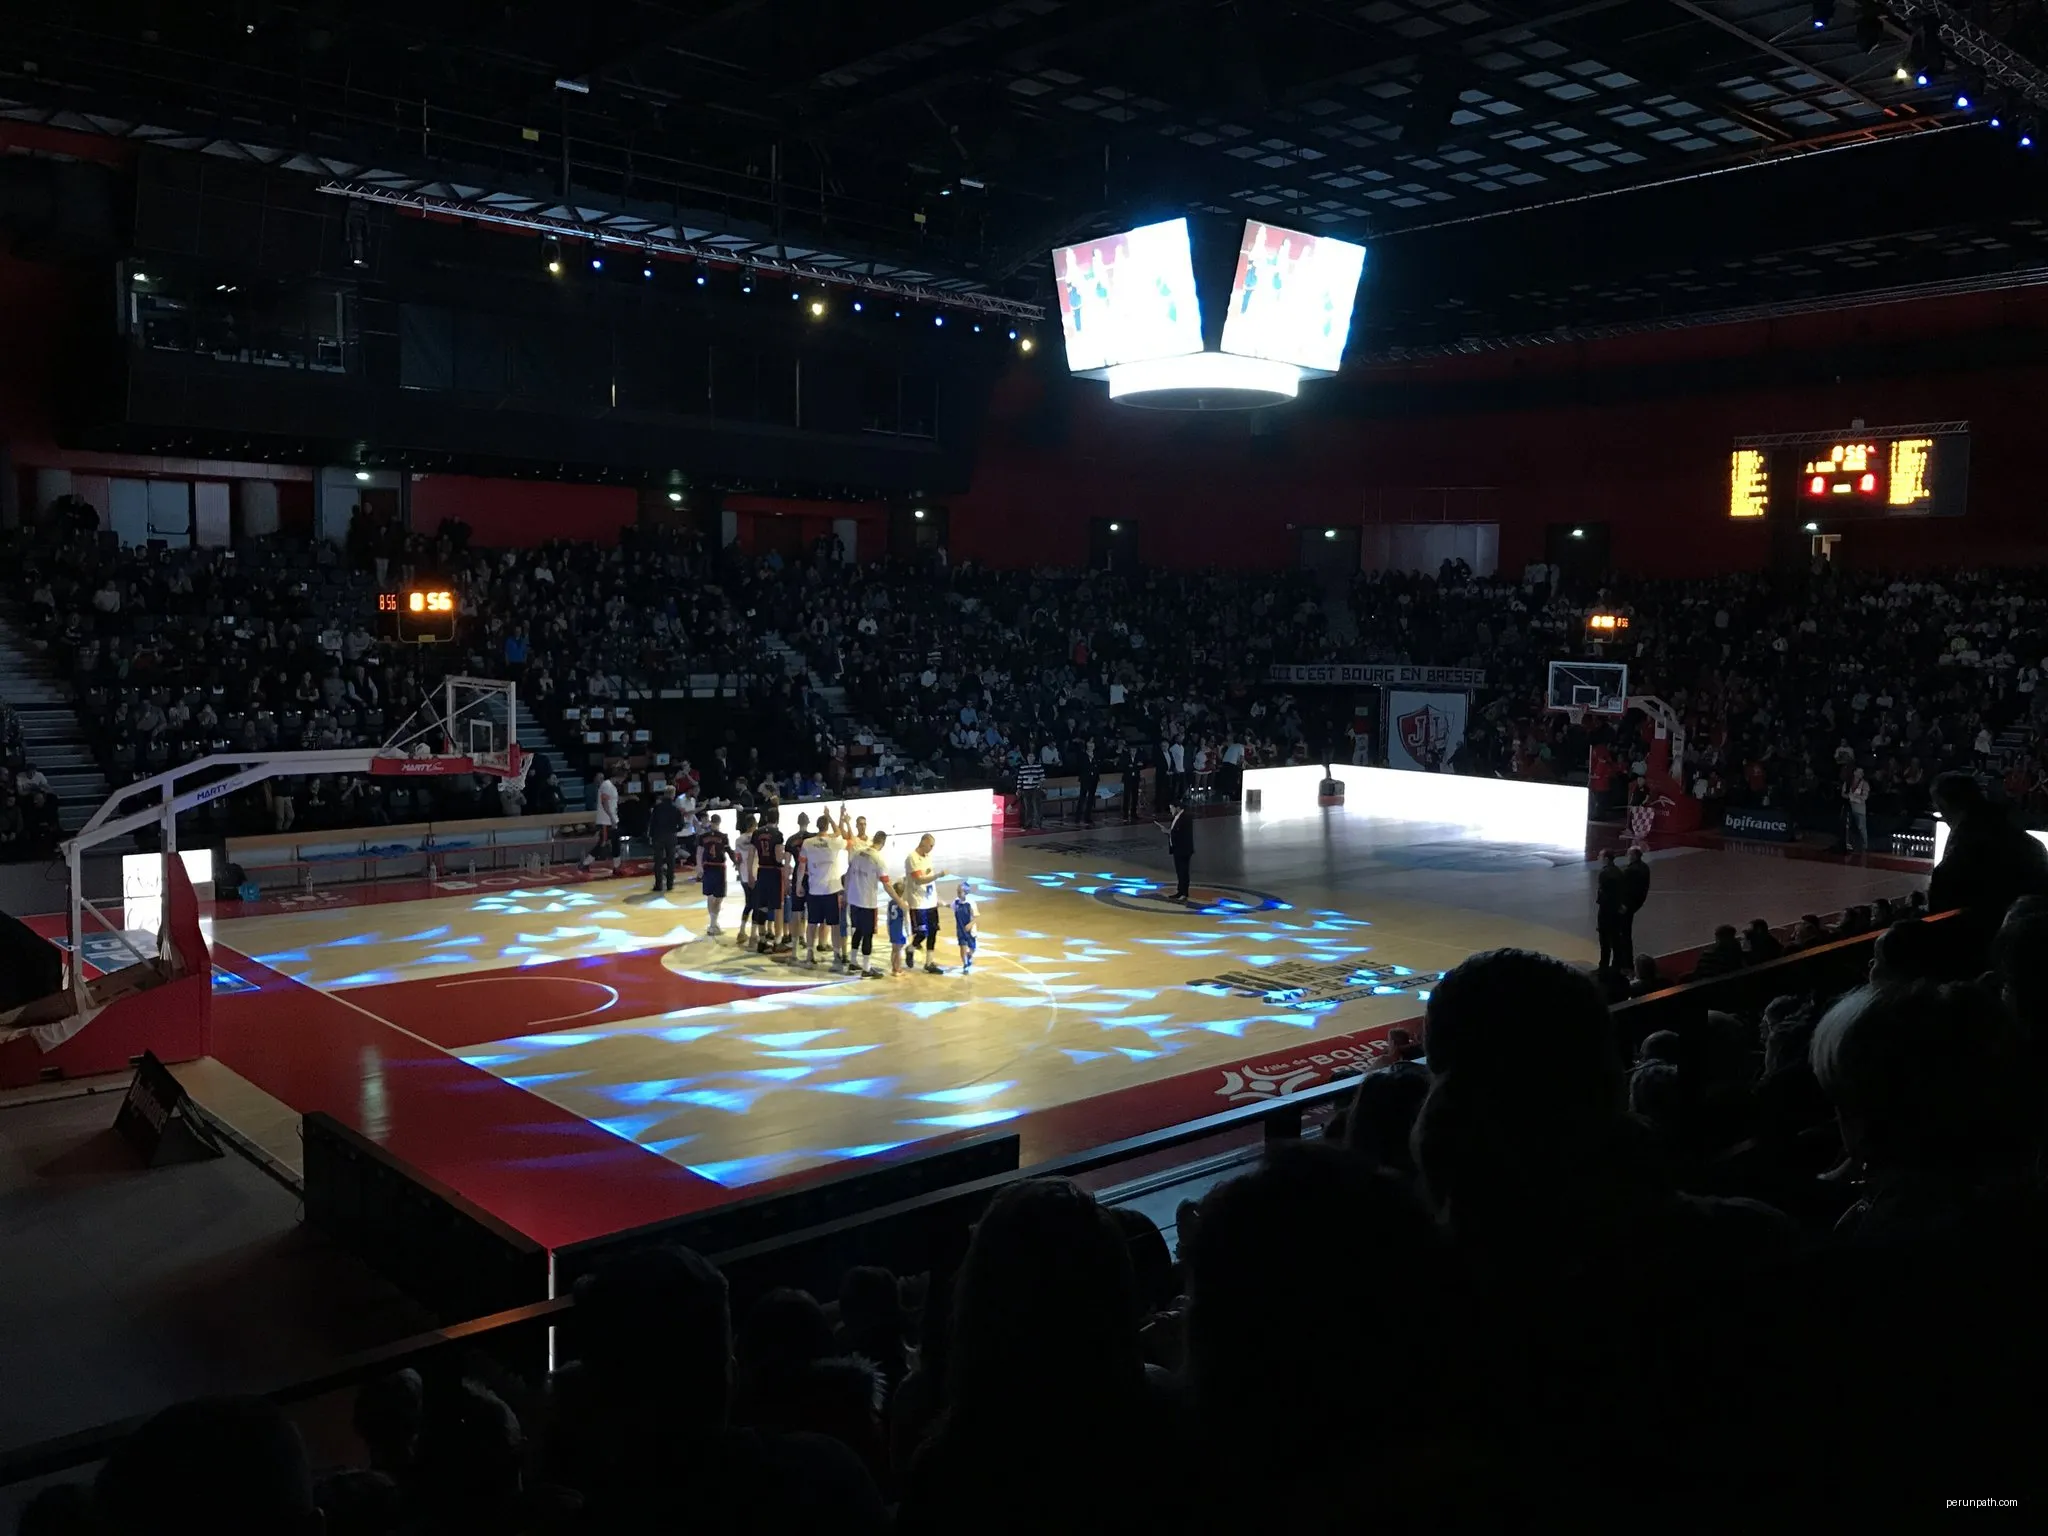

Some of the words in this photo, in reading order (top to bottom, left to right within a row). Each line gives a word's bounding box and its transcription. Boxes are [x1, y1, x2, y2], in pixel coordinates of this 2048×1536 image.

[1342, 667, 1394, 682] BOURG
[1401, 667, 1420, 681] EN
[197, 783, 229, 800] MARTY
[1725, 813, 1787, 832] bpifrance
